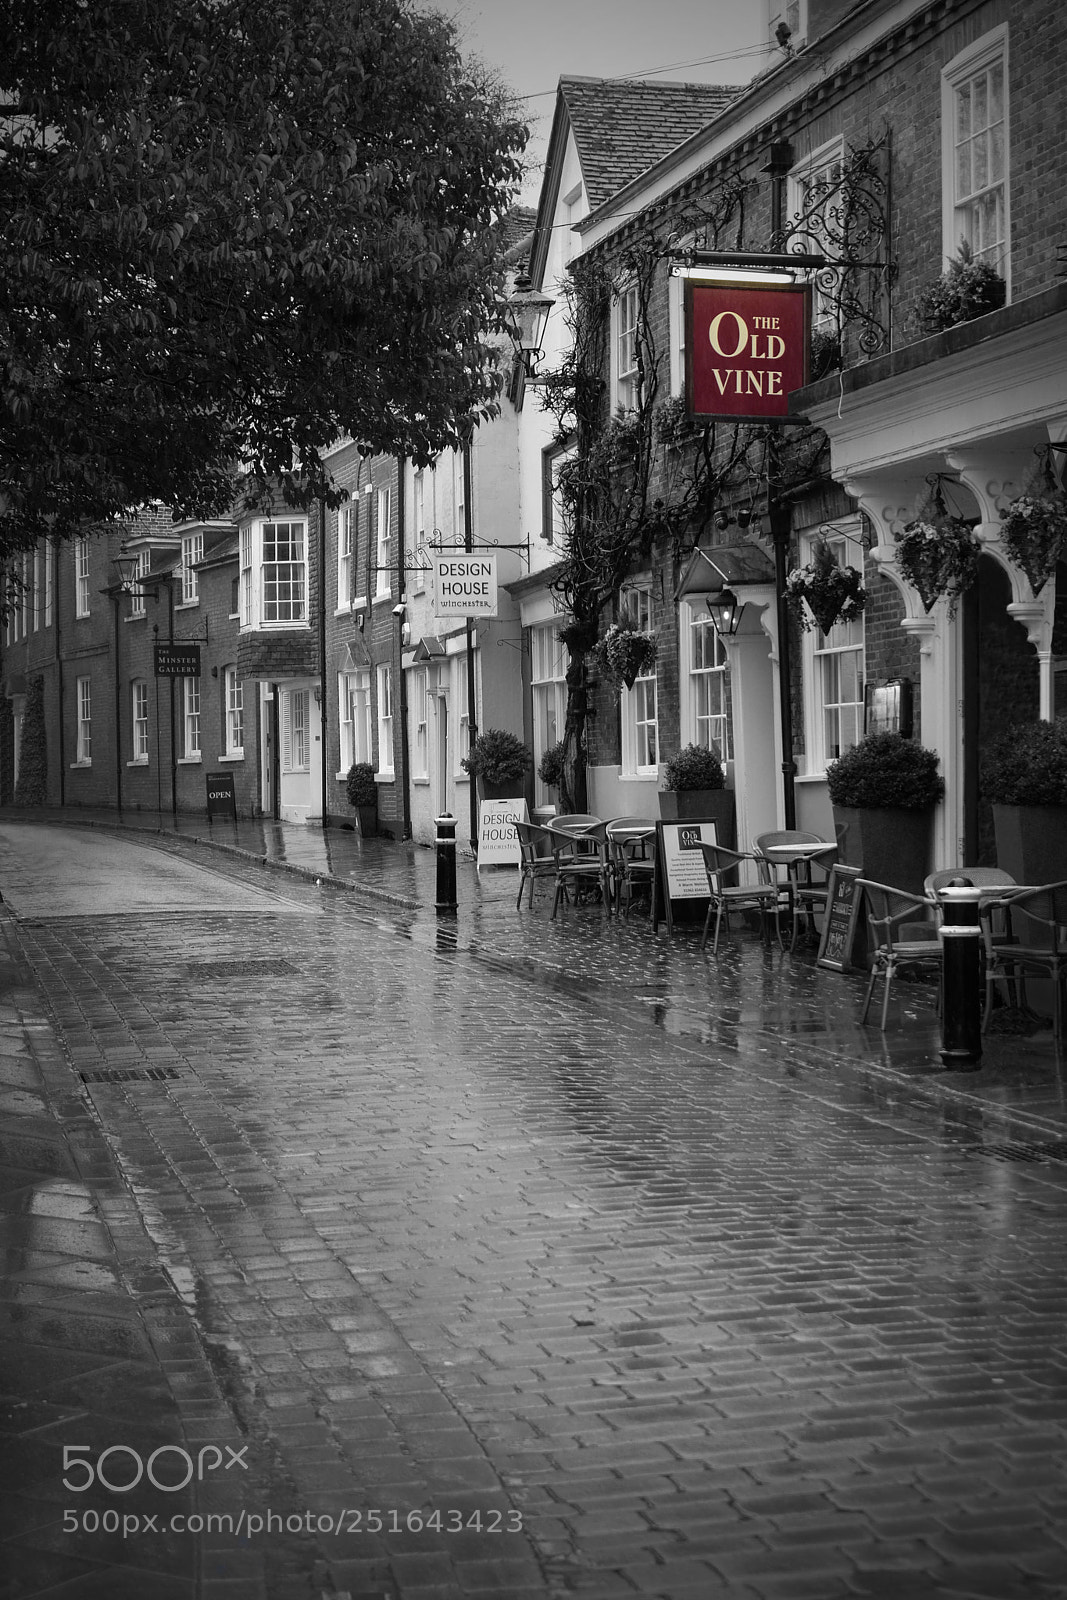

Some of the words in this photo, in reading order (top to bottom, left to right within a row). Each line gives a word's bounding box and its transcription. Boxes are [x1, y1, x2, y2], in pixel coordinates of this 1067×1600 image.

[753, 316, 780, 330] THE
[709, 311, 786, 360] OLD
[711, 368, 783, 397] VINE
[439, 563, 491, 576] DESIGN
[442, 582, 489, 595] HOUSE
[158, 656, 197, 664] MINSTER
[158, 665, 197, 673] GALLERY
[208, 791, 231, 799] OPEN
[483, 813, 521, 825] DESIGN
[482, 828, 519, 841] HOUSE
